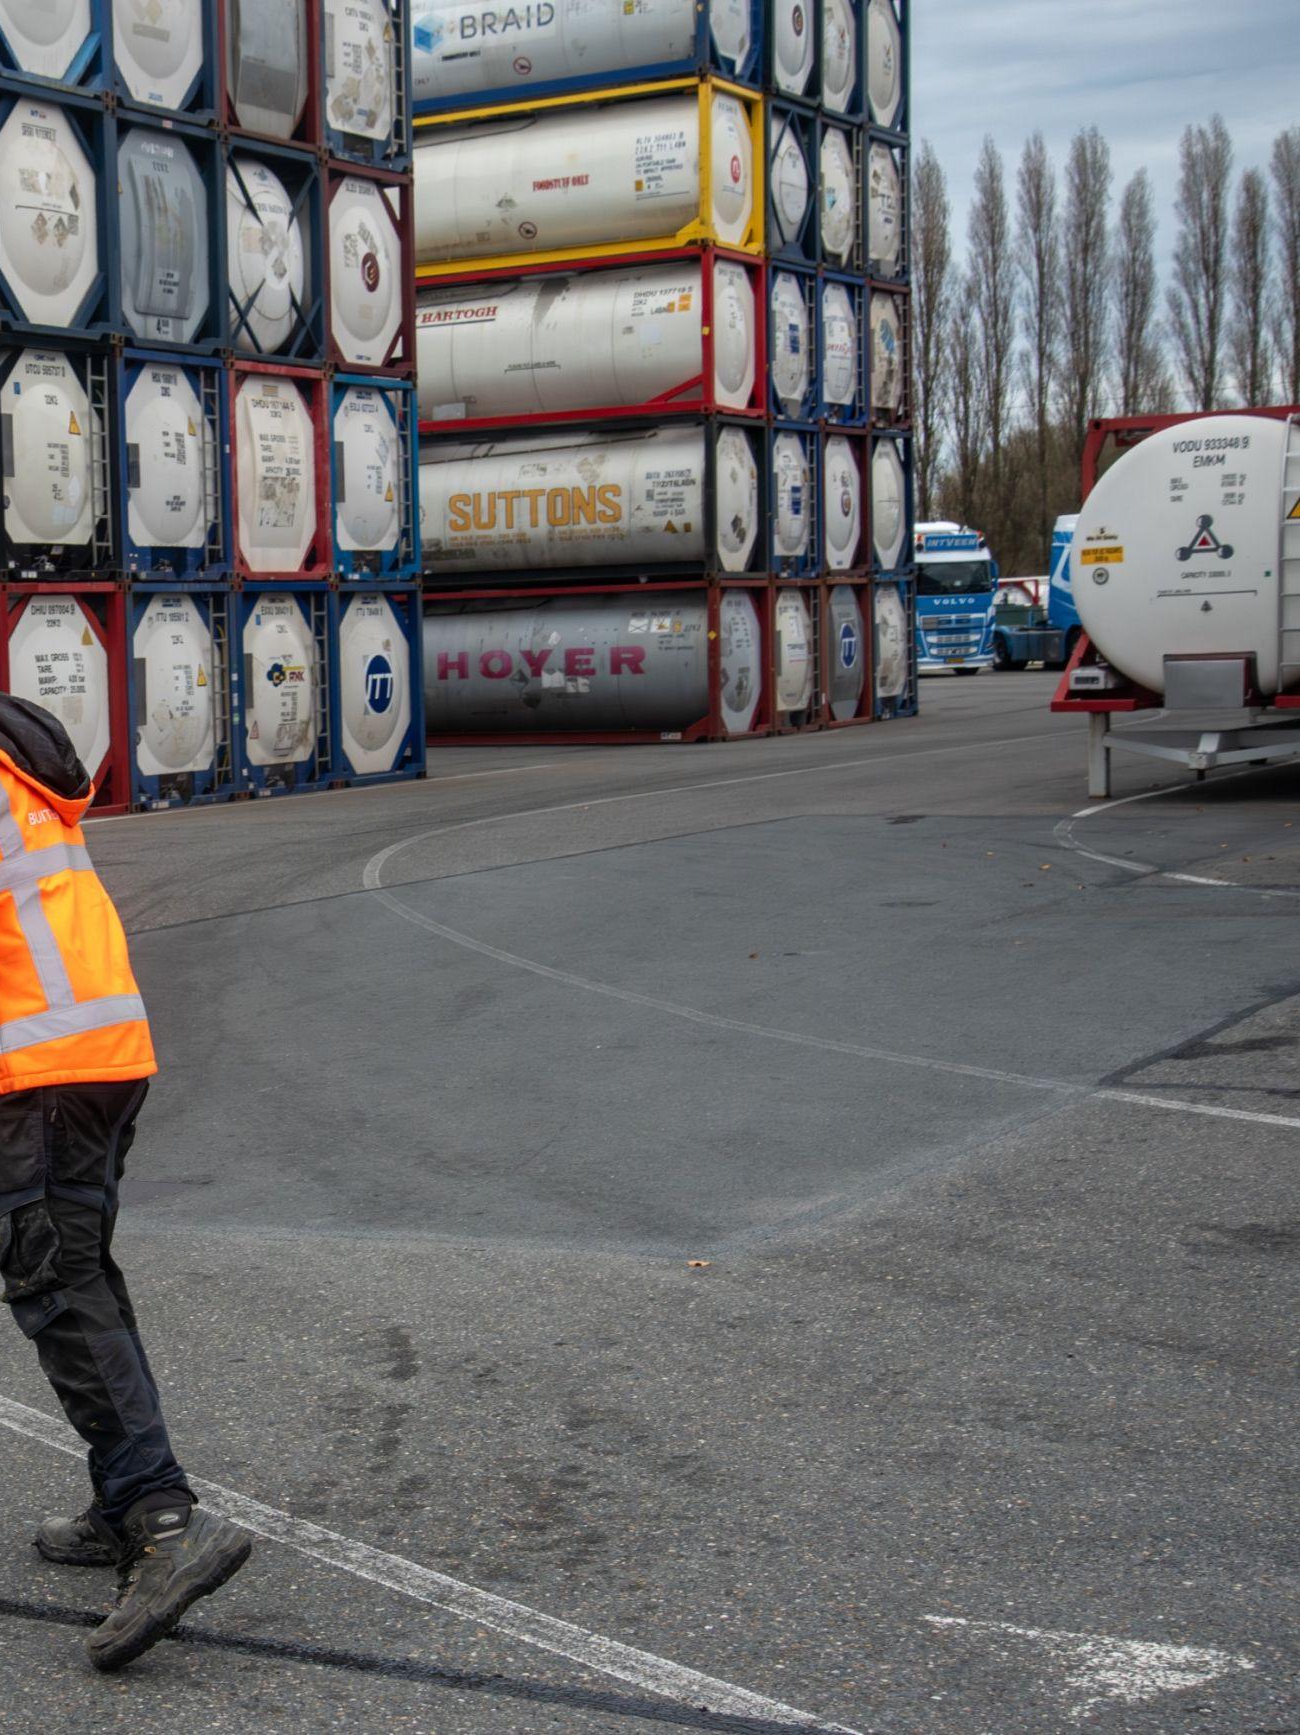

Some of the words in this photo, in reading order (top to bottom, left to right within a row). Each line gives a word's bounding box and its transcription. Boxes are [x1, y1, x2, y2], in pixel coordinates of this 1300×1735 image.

[460, 3, 555, 39] BRAID
[420, 306, 498, 324] HARTOGH
[1172, 440, 1202, 453] VODU
[1204, 437, 1241, 451] 933348
[1193, 454, 1226, 468] EMKM
[450, 483, 622, 532] SUTTONS
[933, 597, 976, 605] VOLVO
[437, 646, 646, 681] HOYER
